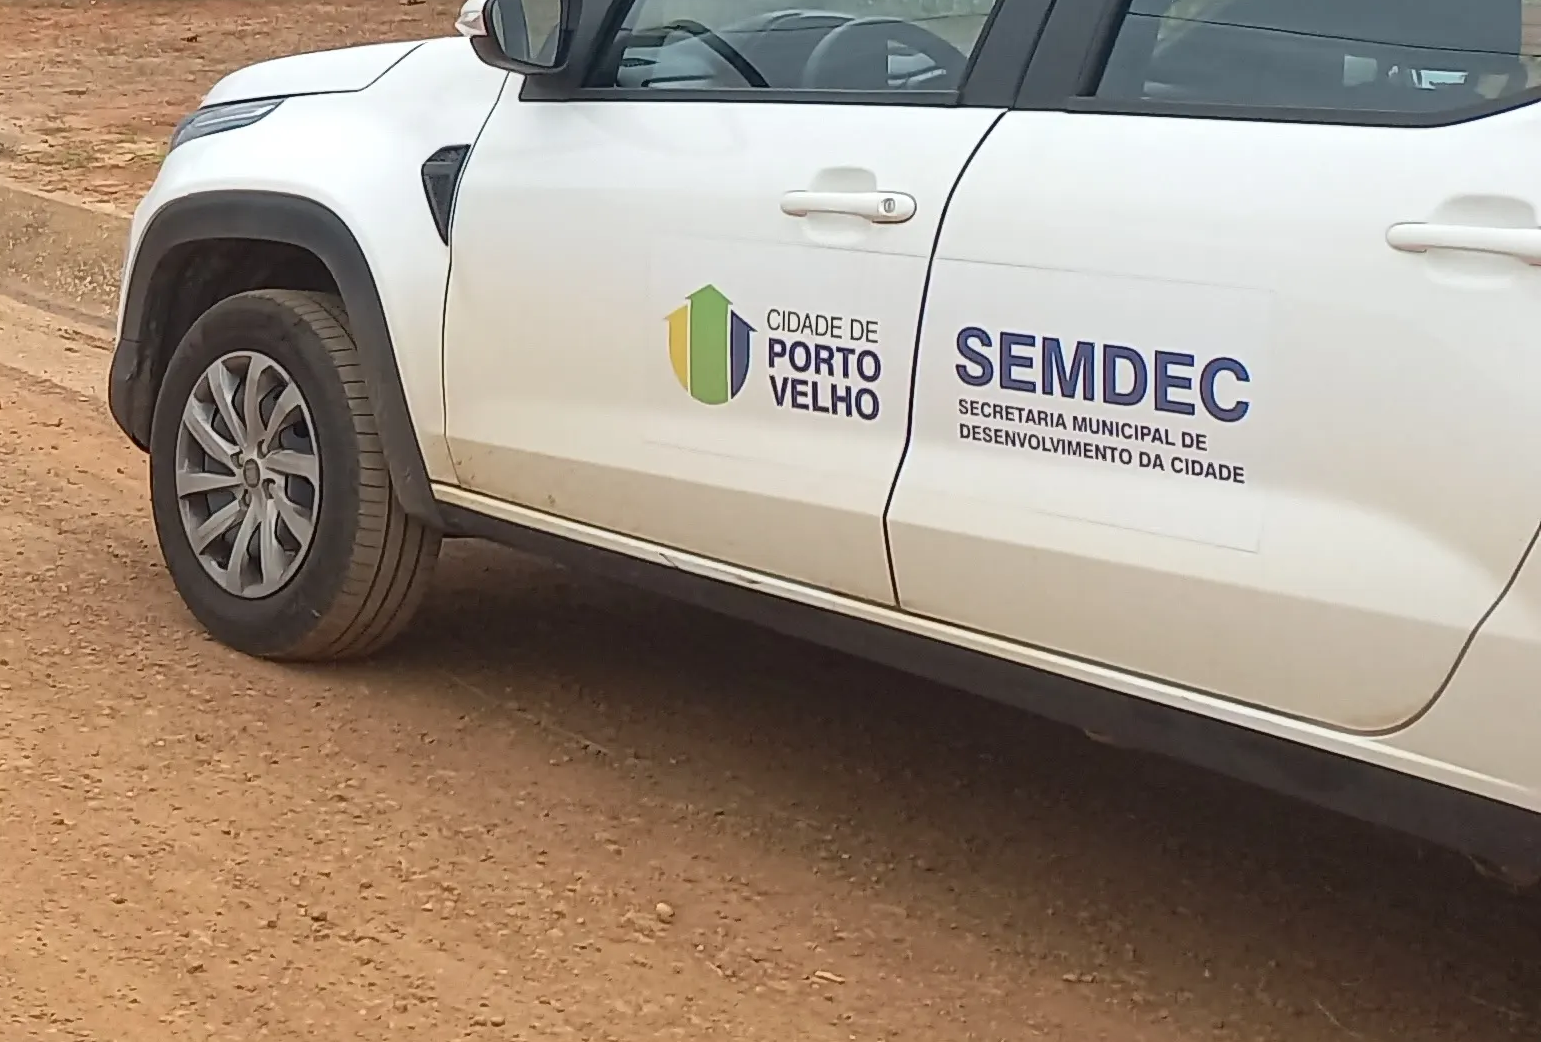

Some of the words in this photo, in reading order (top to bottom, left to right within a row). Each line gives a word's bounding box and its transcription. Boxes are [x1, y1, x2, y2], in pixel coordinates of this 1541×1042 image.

[767, 308, 843, 339] CIDADE
[850, 318, 879, 343] DE
[768, 337, 881, 383] PORTO
[955, 326, 1250, 423] SEMDEC
[769, 374, 880, 421] VELHO
[958, 399, 1067, 430] SECRETARIA
[1072, 415, 1176, 447] MUNICIPAL
[1181, 431, 1208, 451] DE
[959, 423, 1133, 466] DESENVOLVIMENTO
[1139, 451, 1165, 471] DA
[1171, 457, 1246, 484] CIDADE
